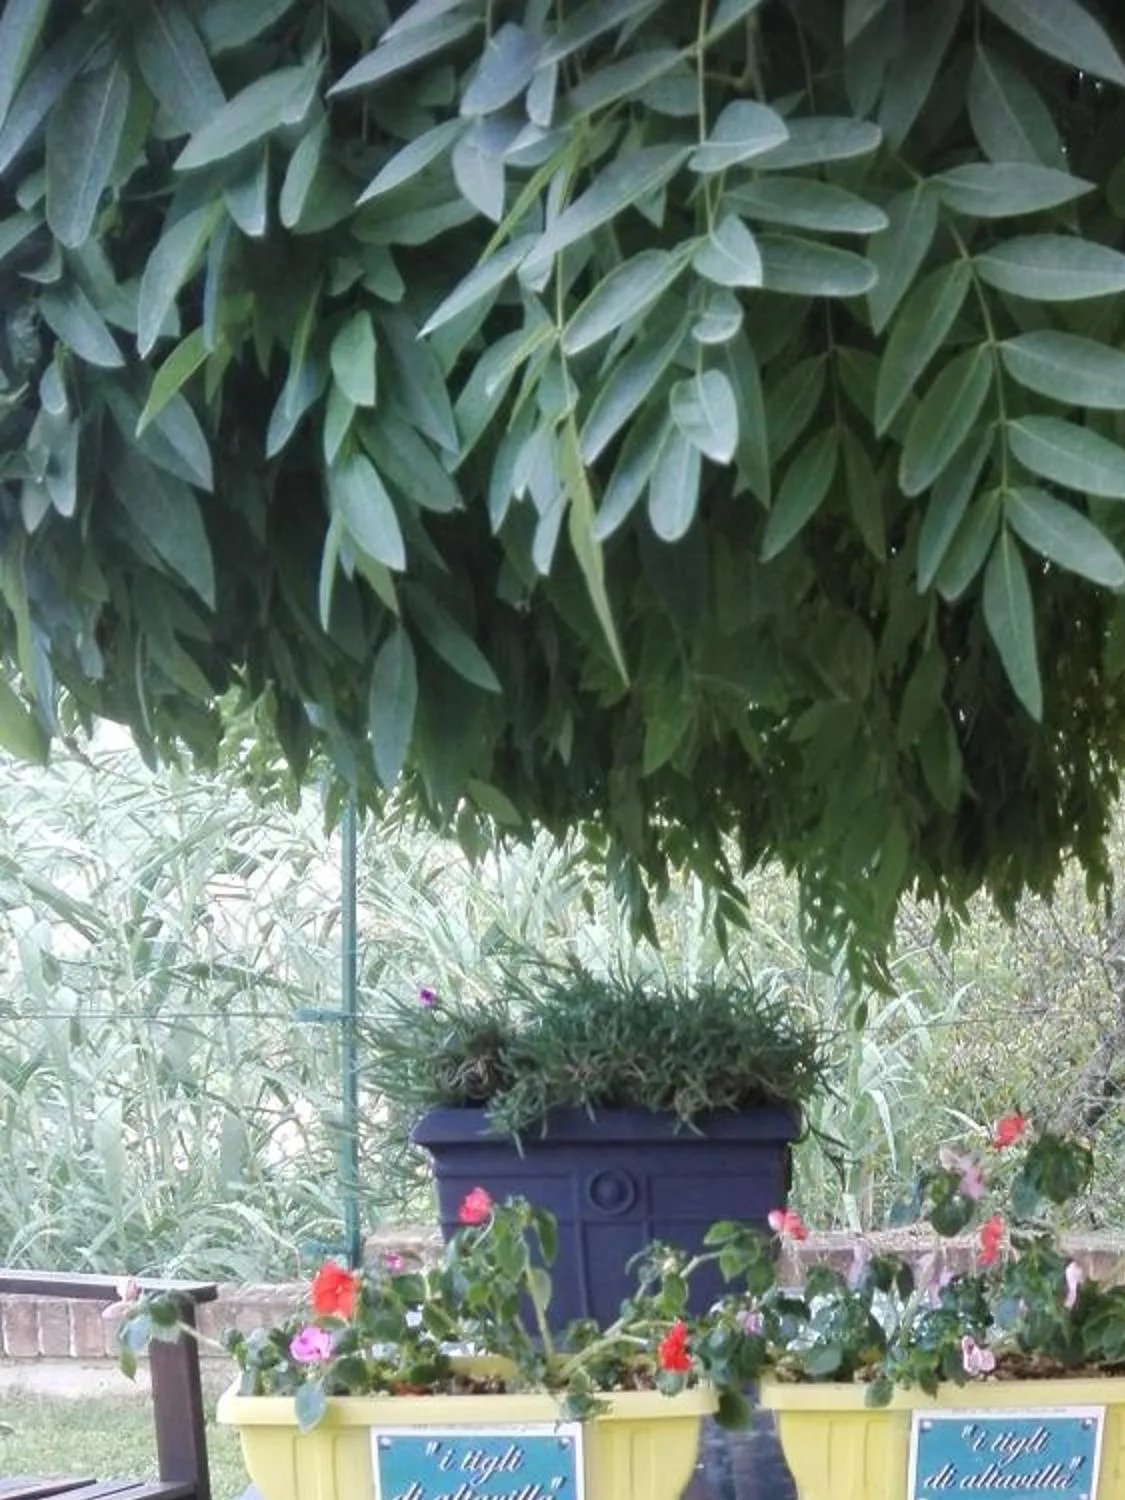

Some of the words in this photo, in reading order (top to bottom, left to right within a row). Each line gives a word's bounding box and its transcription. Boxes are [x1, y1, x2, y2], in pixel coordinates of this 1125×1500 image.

[460, 1444, 525, 1486] tigli
[991, 1426, 1052, 1466] tigli
[923, 1462, 958, 1490] di
